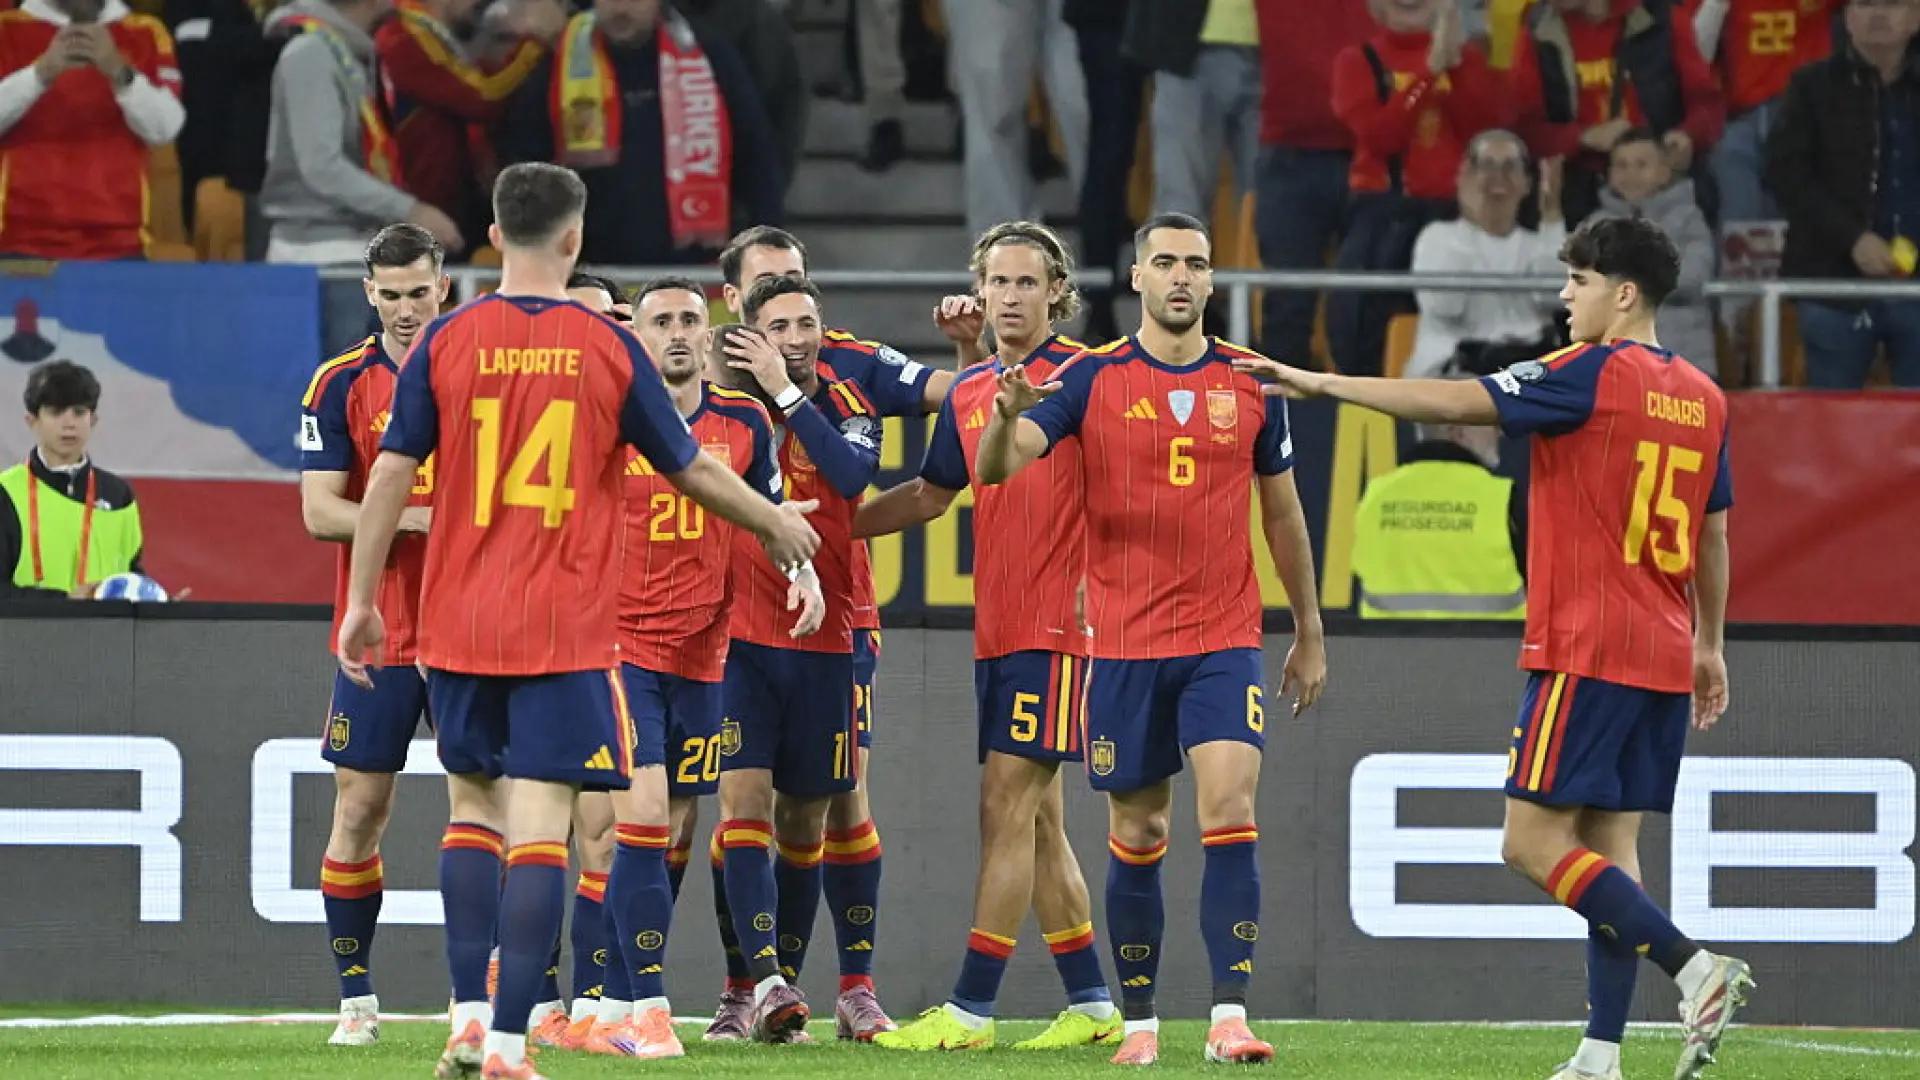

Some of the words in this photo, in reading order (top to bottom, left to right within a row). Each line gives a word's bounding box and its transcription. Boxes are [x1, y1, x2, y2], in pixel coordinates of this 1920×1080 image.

[1748, 10, 1796, 53] 22
[478, 347, 581, 376] LAPORTE
[472, 397, 576, 528] 14
[1169, 437, 1195, 485] 6
[650, 493, 704, 541] 20
[1381, 500, 1477, 515] SEGURIDAD
[1624, 440, 1703, 574] 15
[1010, 692, 1040, 742] 5
[1247, 685, 1265, 733] 6
[676, 733, 721, 783] 20
